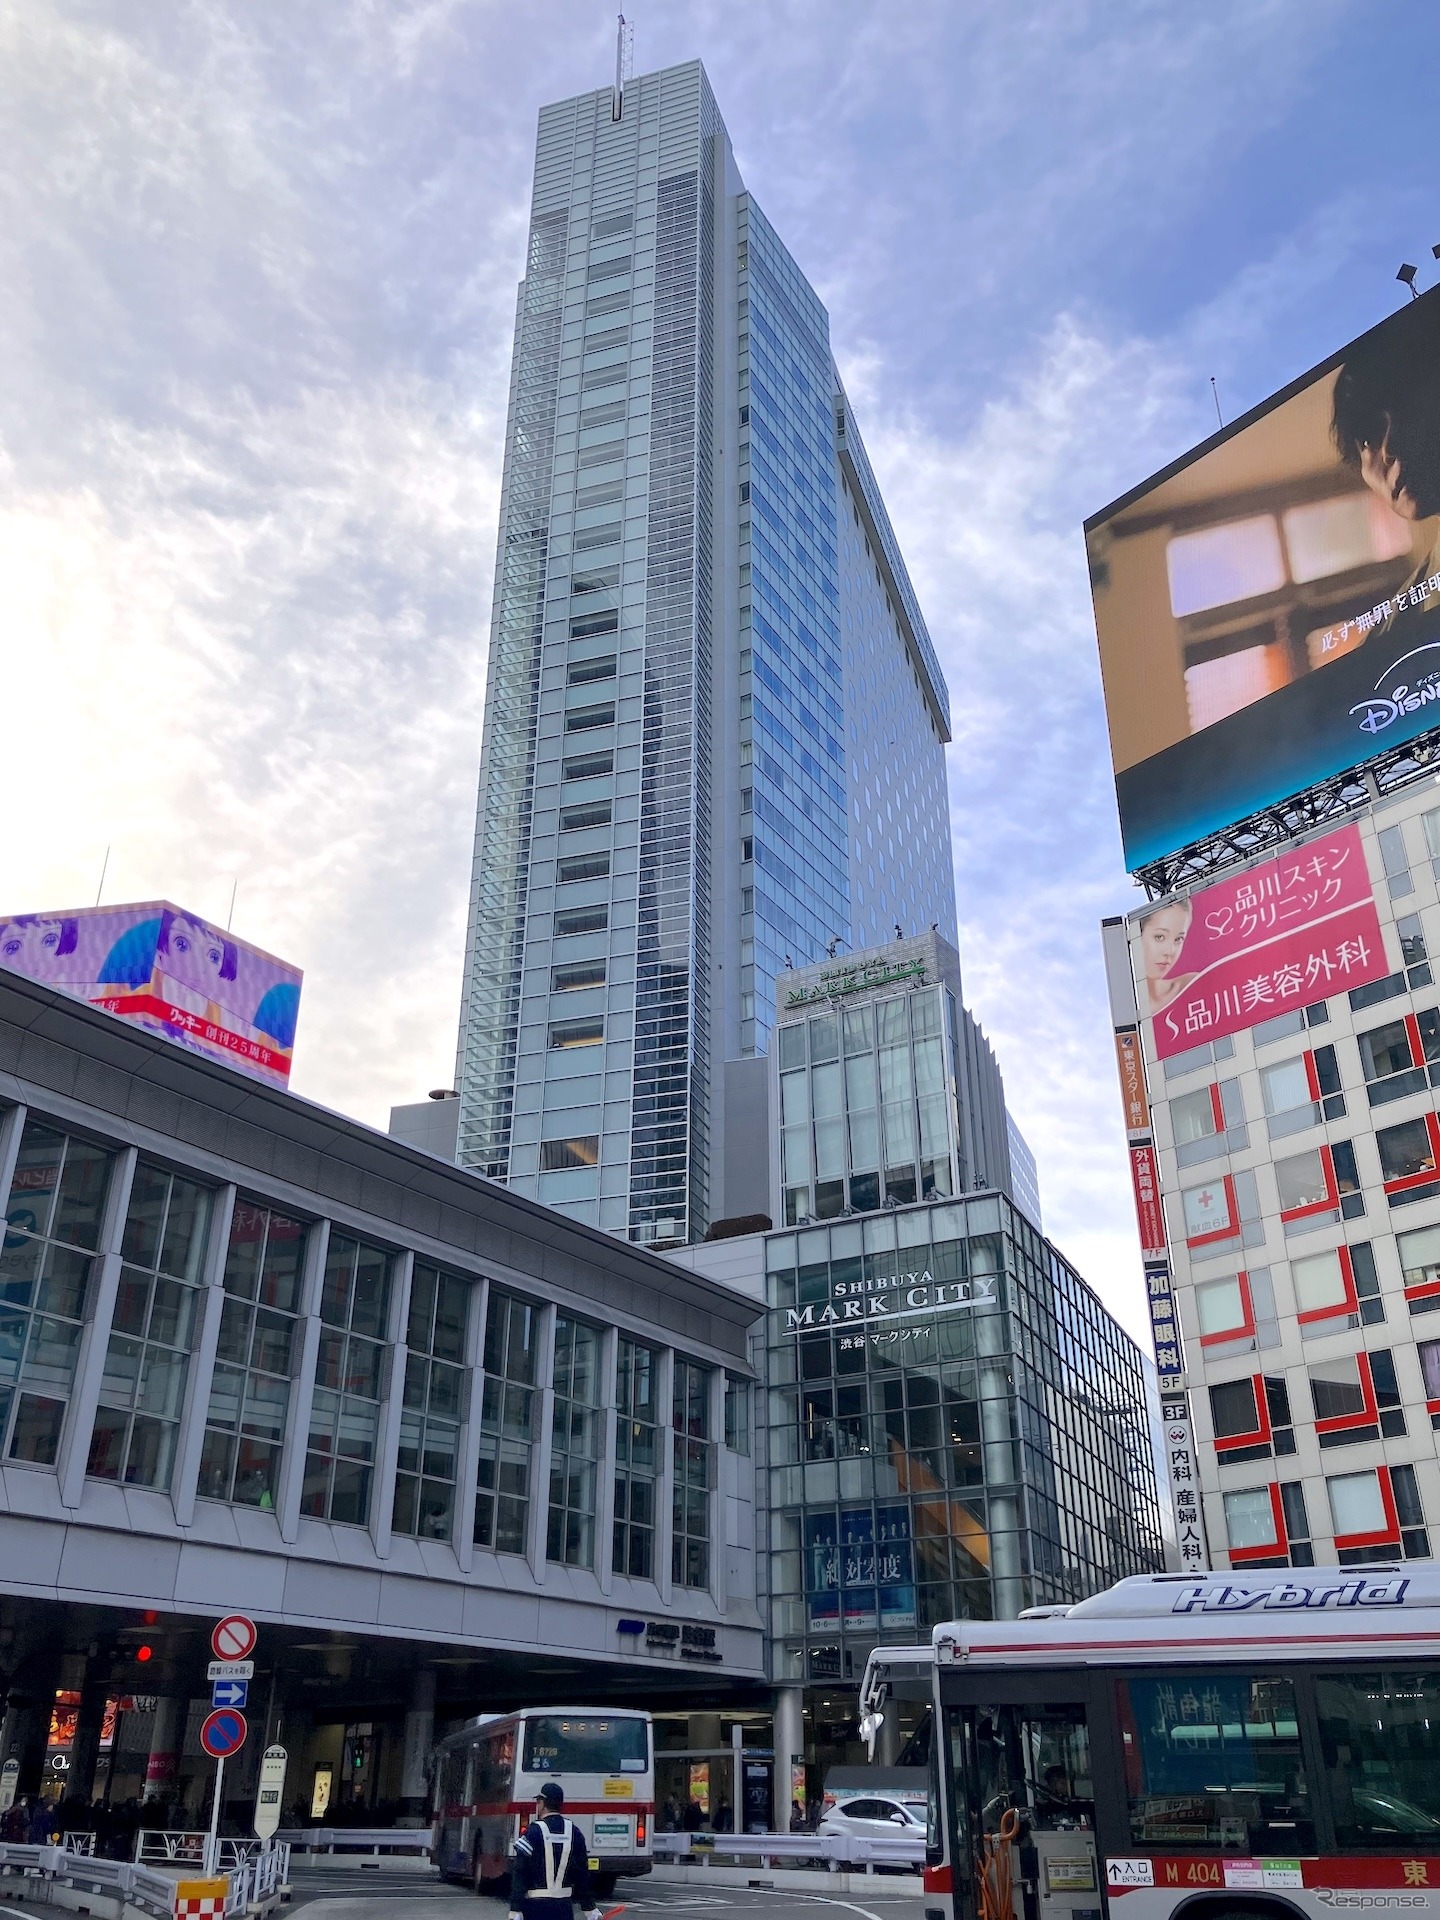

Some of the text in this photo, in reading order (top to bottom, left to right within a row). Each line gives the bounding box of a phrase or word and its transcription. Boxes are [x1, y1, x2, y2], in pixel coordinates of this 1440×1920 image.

[1234, 847, 1350, 912] 品川スキン
[1238, 877, 1342, 938] クリニック
[787, 976, 857, 1004] MARK
[1184, 935, 1371, 1034] 品川美容外科
[1122, 1049, 1144, 1126] 東京スター銀行
[834, 1270, 933, 1297] SHIBUYA
[785, 1277, 996, 1328] MARK CITY
[1148, 1275, 1179, 1369] 加藤眼科
[840, 1327, 932, 1350] 渋谷 マークシティ
[1162, 1377, 1180, 1389] 5F
[1165, 1405, 1186, 1420] 3F
[1171, 1579, 1411, 1613] Hybrid
[1122, 1875, 1152, 1883] ENTRANCE
[1124, 1862, 1148, 1875] 入口
[1165, 1863, 1221, 1883] M 404
